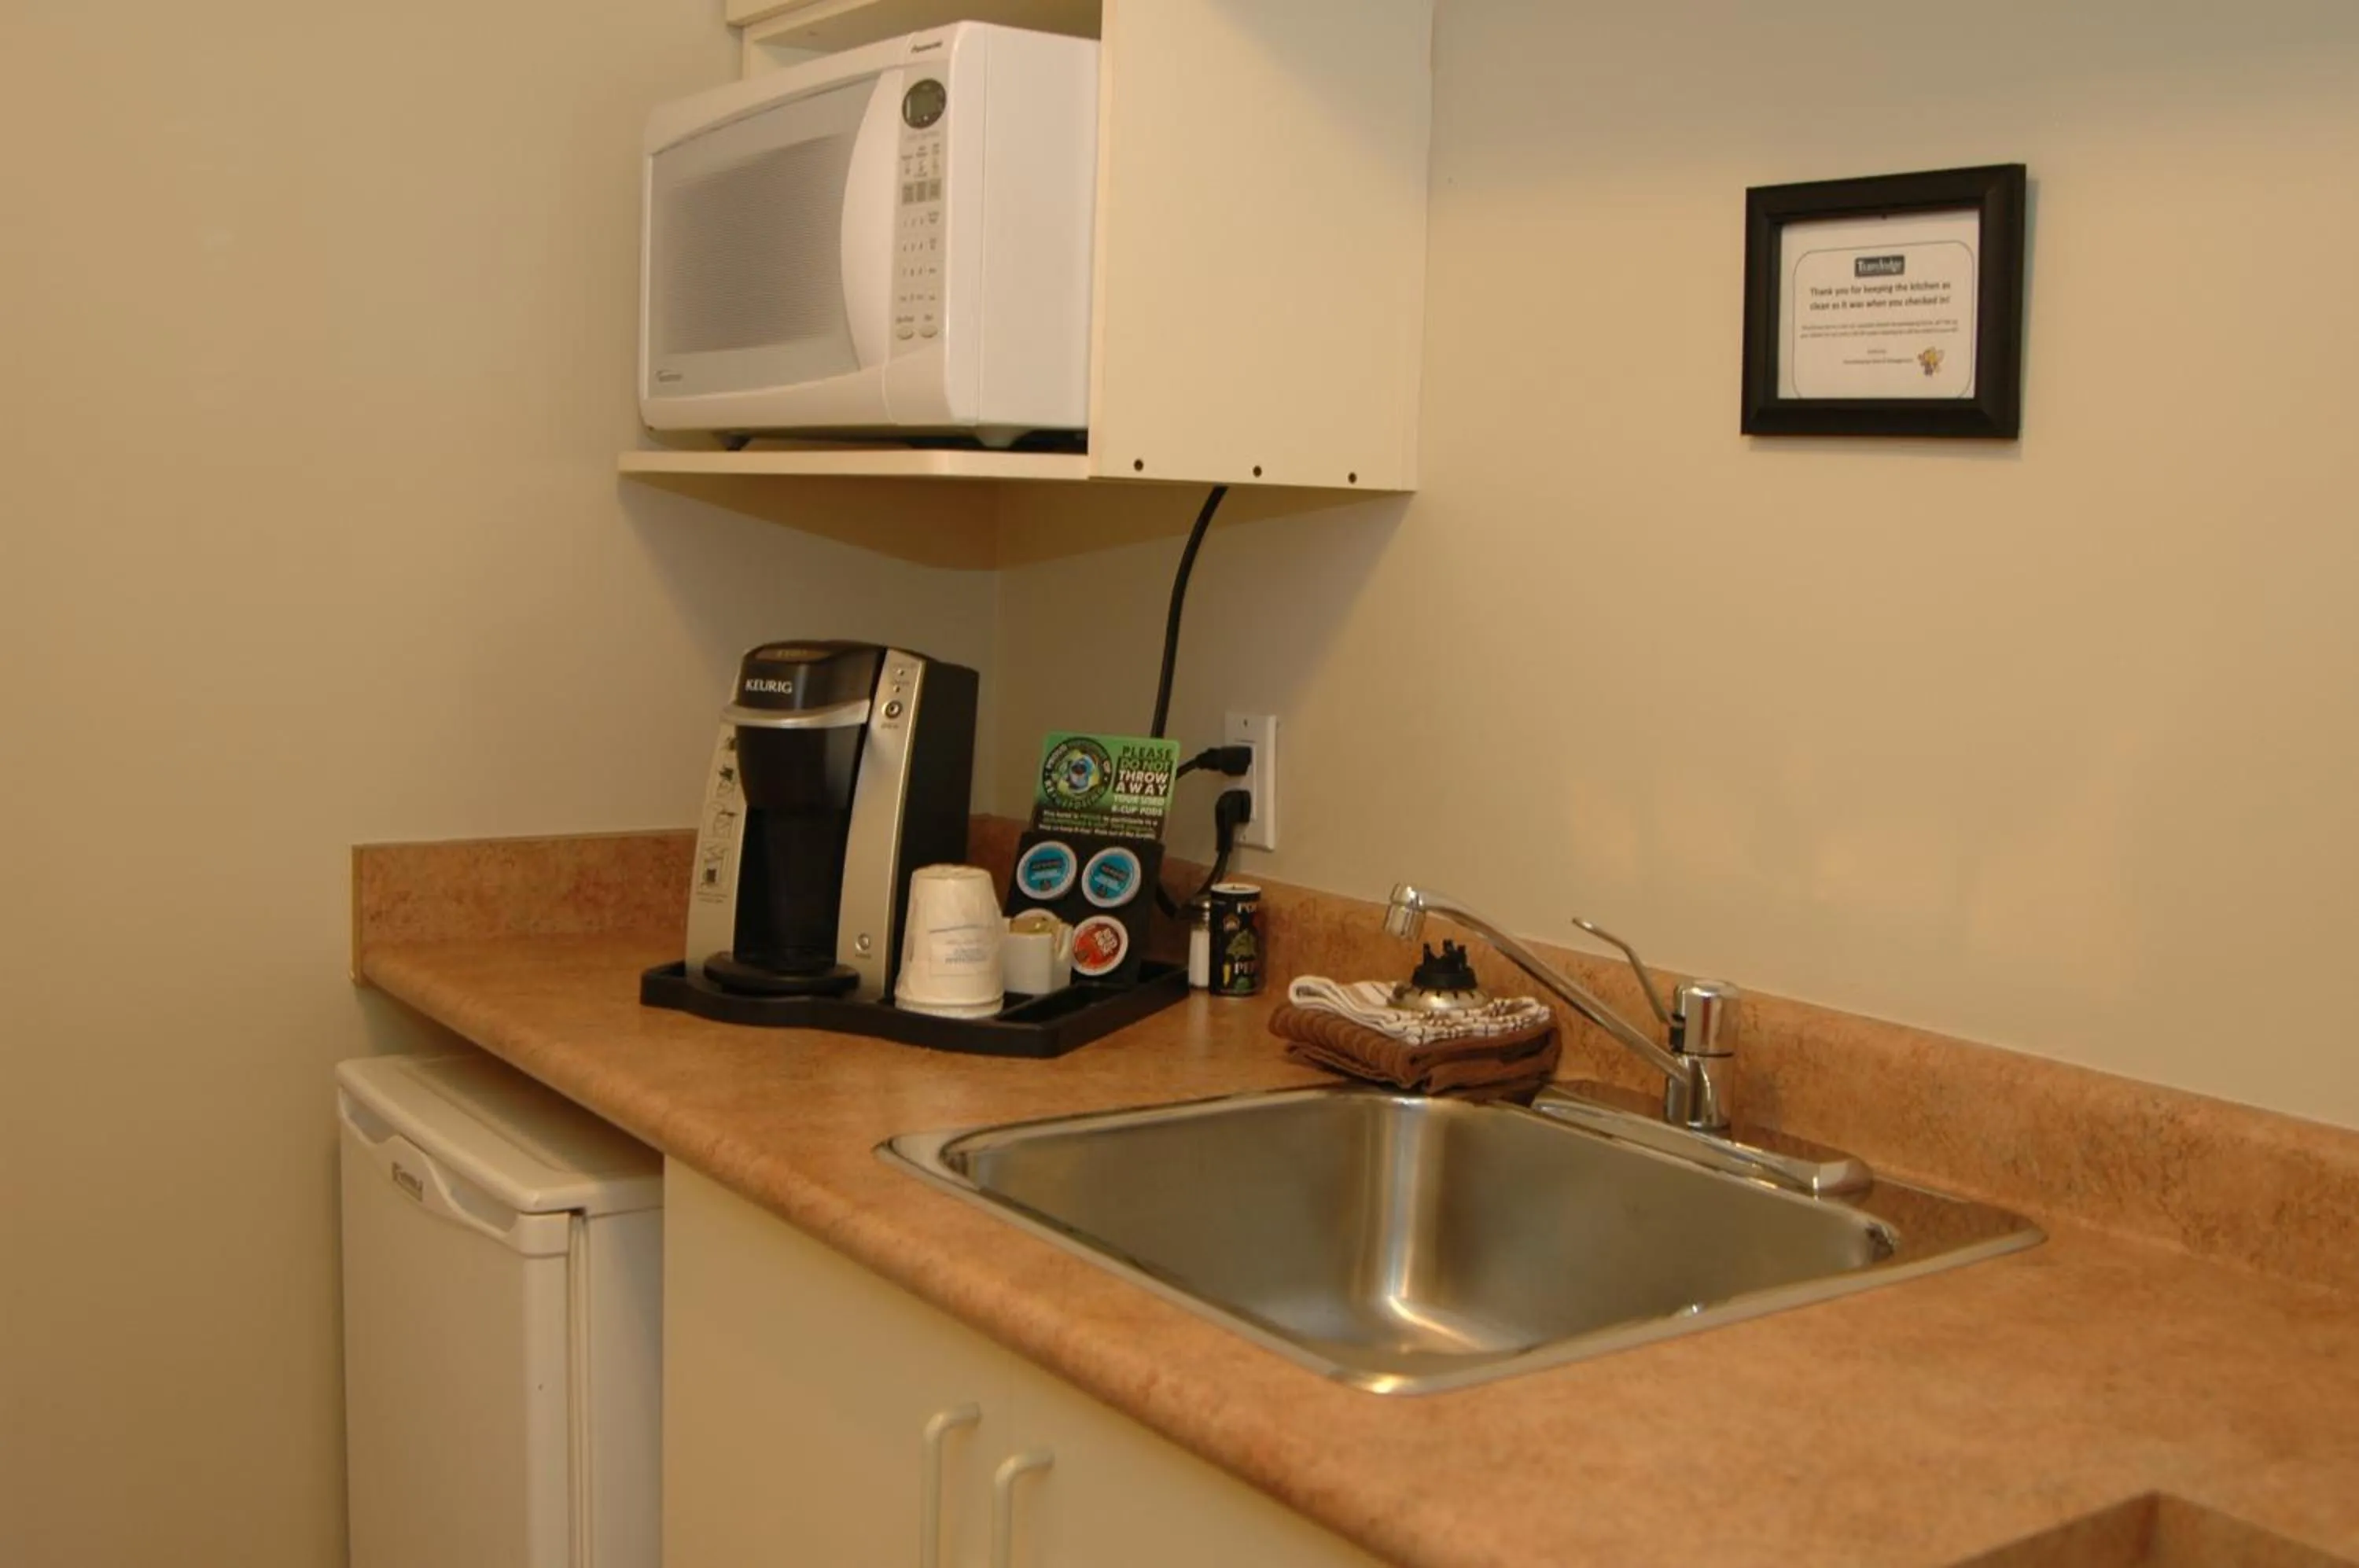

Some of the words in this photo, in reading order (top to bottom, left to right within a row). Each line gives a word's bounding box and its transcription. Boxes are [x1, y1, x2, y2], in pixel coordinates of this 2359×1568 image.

[1811, 287, 1833, 296] Thank
[1835, 288, 1849, 296] you
[1864, 285, 1893, 295] keeping
[1910, 281, 1940, 290] kitchen
[1810, 302, 1830, 311] clean
[1889, 299, 1903, 307] you
[1904, 296, 1938, 306] checked
[745, 679, 793, 694] KEURIG
[1122, 745, 1172, 760] PLEASE
[1121, 758, 1139, 770] DO
[1143, 759, 1171, 772] NOT
[1119, 770, 1168, 783] THROW
[1115, 781, 1167, 796] AWAY
